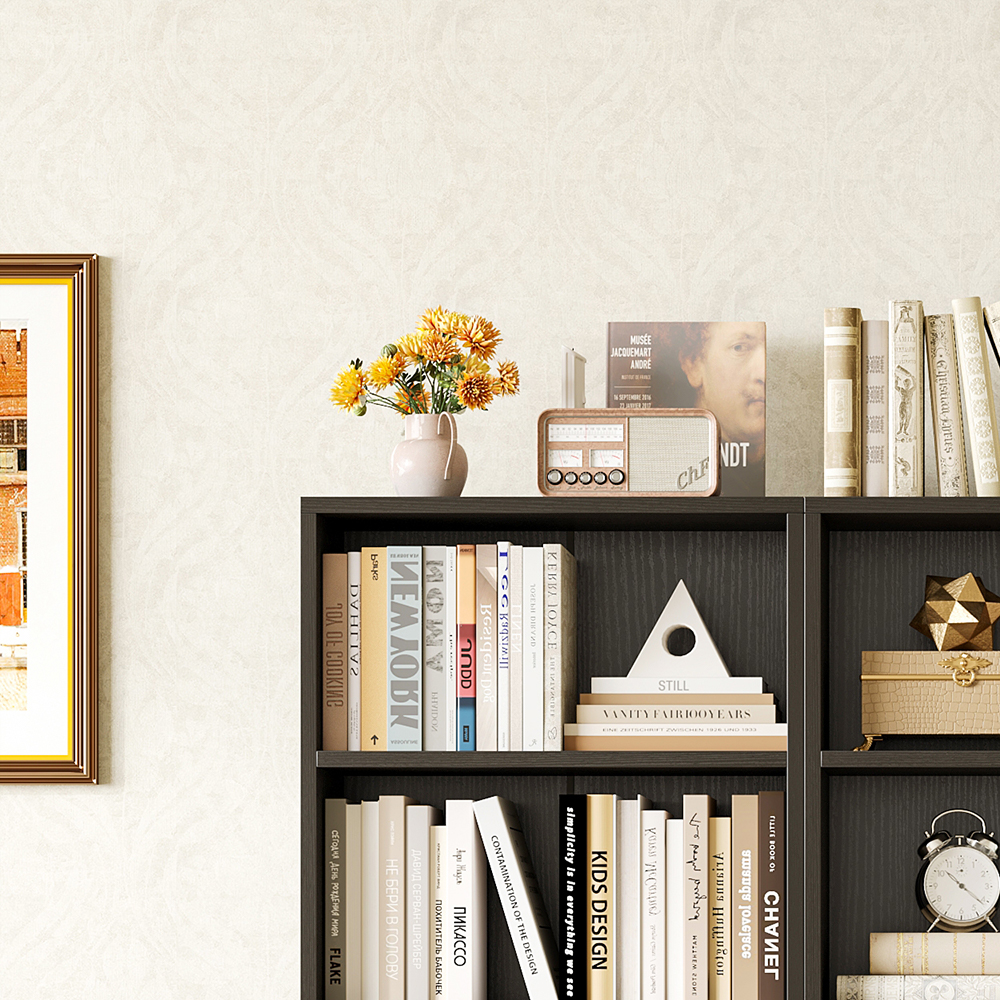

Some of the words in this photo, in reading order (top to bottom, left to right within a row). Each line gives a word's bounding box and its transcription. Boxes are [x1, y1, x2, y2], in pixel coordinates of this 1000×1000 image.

[611, 348, 651, 357] JACQUEMART
[630, 334, 652, 345] MUSÉE
[630, 360, 651, 369] ANDRÉ
[658, 680, 690, 691] STILL
[564, 806, 575, 864] simplicity
[386, 859, 398, 875] НЕ
[411, 849, 421, 882] ДАВИД
[490, 835, 519, 909] CONTAMINATION
[566, 867, 575, 877] is
[591, 850, 607, 894] KIDS
[386, 879, 398, 914] БЕРИ
[566, 880, 576, 892] in
[386, 916, 398, 925] В
[412, 883, 422, 969] СЕРВАН-ШРЕЙБЕР
[513, 910, 521, 923] OF
[519, 923, 528, 941] THE
[564, 895, 576, 956] everything
[453, 906, 466, 967] ПИКАССО
[591, 900, 607, 970] DESIGN
[329, 948, 340, 985] FLAKE
[386, 928, 398, 980] ГОЛОВУ
[523, 942, 539, 976] DESIGN
[566, 959, 573, 975] we
